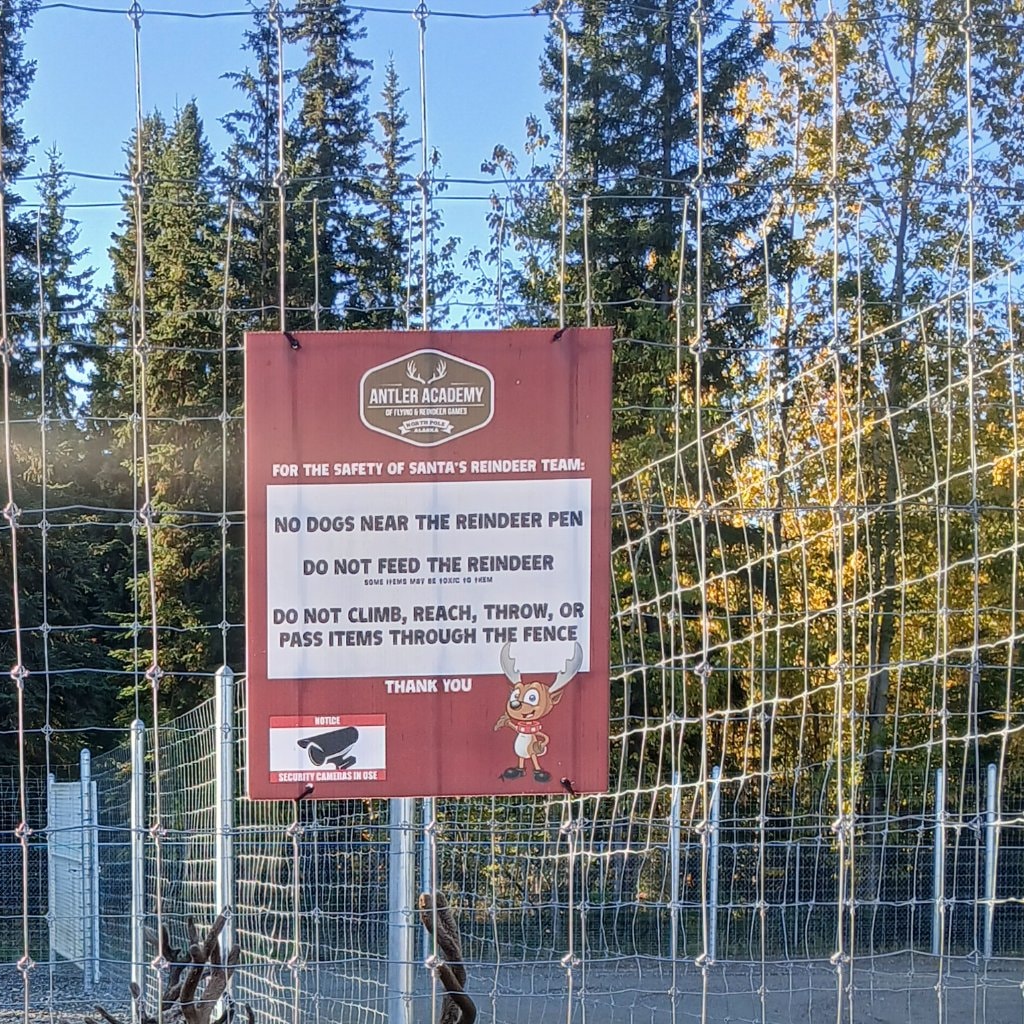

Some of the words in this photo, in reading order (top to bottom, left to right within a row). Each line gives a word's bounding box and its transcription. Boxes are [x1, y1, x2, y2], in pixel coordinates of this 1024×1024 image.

[369, 388, 418, 404] ANTLER
[421, 387, 484, 403] ACADEMY
[448, 407, 467, 415] GAMES
[272, 464, 299, 477] FOR
[303, 463, 330, 476] THE
[333, 462, 383, 476] SAFETY
[387, 462, 405, 475] OF
[409, 460, 467, 475] SANTA'S
[471, 459, 537, 474] REINDEER
[541, 458, 585, 472] TEAM:
[275, 516, 301, 533] NO
[306, 515, 355, 533] DOGS
[360, 515, 409, 532] NEAR
[415, 514, 450, 531] THE
[456, 512, 542, 530] REINDEER
[548, 510, 583, 528] PEN
[303, 559, 329, 575] DO
[334, 558, 372, 575] NOT
[378, 557, 421, 574] FEED
[427, 556, 462, 573] THE
[467, 555, 554, 572] REINDEER
[273, 608, 299, 625] DO
[304, 608, 342, 624] NOT
[348, 606, 408, 625] CLIMB,
[413, 605, 478, 623] REACH,
[484, 603, 554, 622] THROW,
[559, 602, 585, 618] OR
[279, 631, 323, 648] PASS
[328, 630, 383, 647] ITEMS
[389, 628, 477, 646] THROUGH
[483, 627, 518, 643] THE
[523, 625, 578, 642] FENCE
[385, 679, 437, 694] THANK
[443, 678, 473, 693] YOU
[314, 716, 341, 725] NOTICE
[278, 773, 315, 782] SECURITY
[316, 772, 352, 781] CAMERAS
[353, 771, 362, 780] IN
[364, 771, 378, 780] USE
